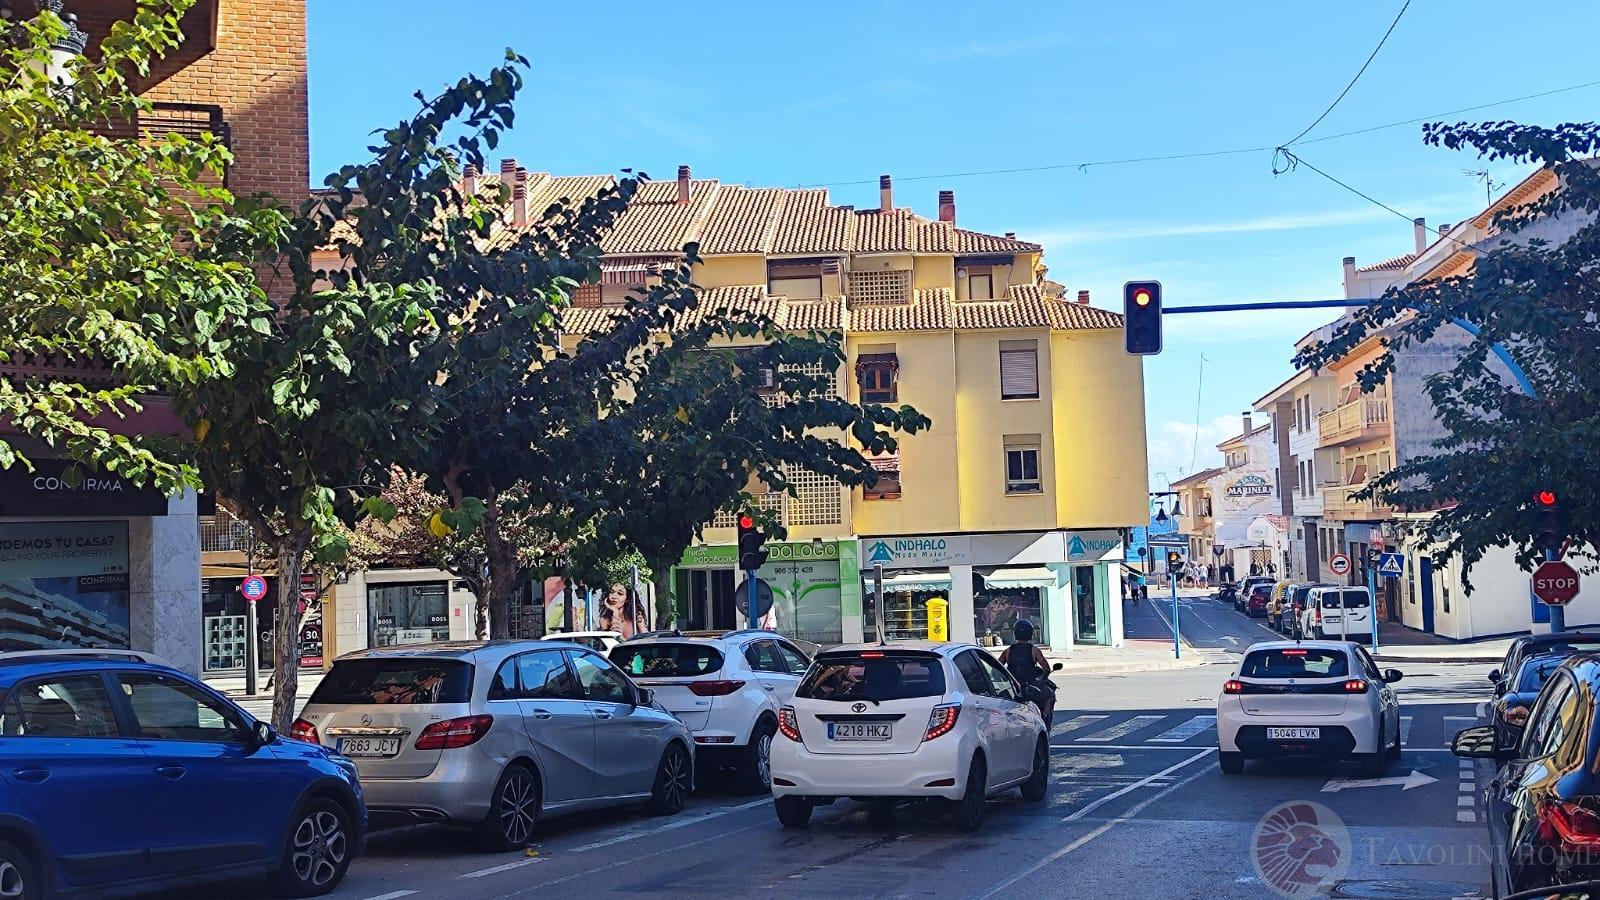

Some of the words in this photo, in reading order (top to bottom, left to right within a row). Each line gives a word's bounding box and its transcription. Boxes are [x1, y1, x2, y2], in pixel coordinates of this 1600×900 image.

[33, 477, 123, 491] CONIRMA
[55, 538, 72, 548] TU
[75, 536, 115, 548] CASA?
[895, 539, 946, 551] INDHALO
[1086, 540, 1121, 550] INDHALO
[36, 551, 60, 560] YOUR
[769, 544, 836, 559] DOLOGO
[80, 575, 126, 585] CONFIRMA
[1537, 578, 1576, 589] STOP
[835, 725, 864, 737] 4218
[867, 725, 889, 737] HKZ
[1274, 728, 1297, 738] 5046
[1300, 728, 1318, 738] LVK
[342, 740, 371, 752] 7663
[374, 739, 397, 752] JCY
